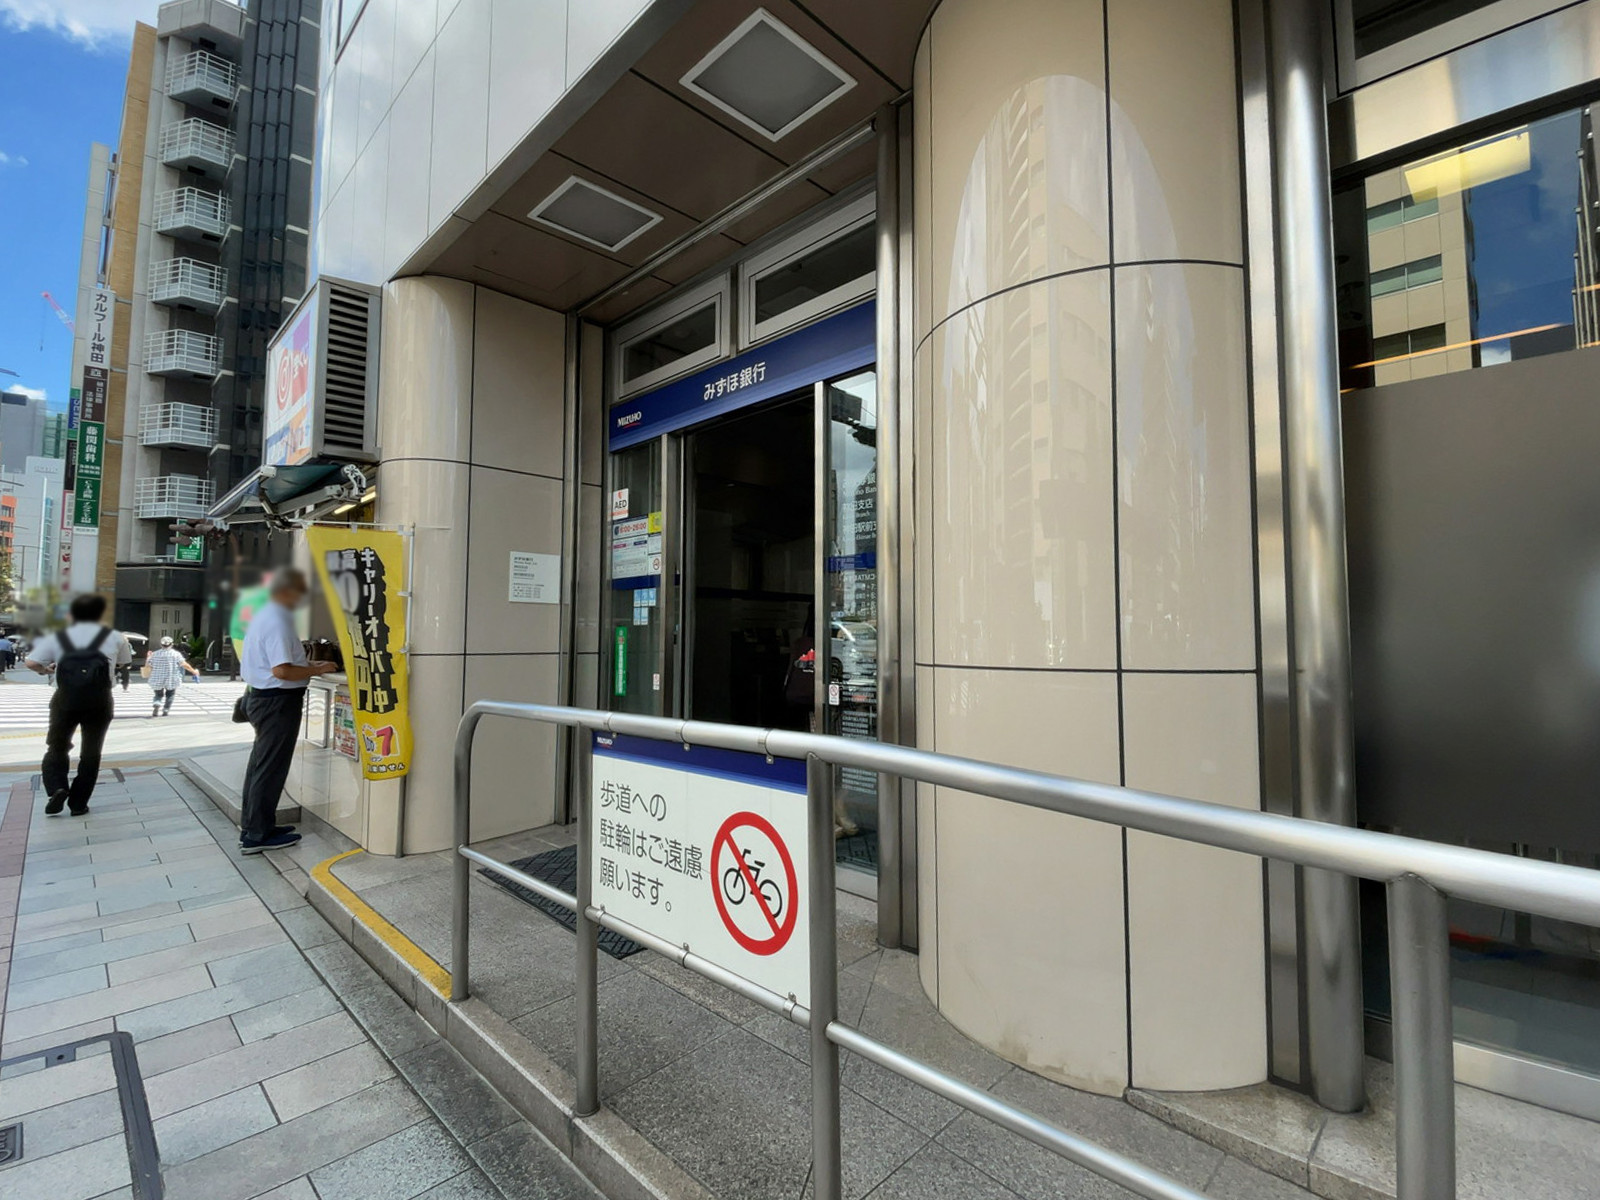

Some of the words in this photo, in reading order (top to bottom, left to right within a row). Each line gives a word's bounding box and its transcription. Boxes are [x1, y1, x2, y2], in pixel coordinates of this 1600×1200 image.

[90, 293, 107, 364] カルフール神田
[703, 361, 767, 401] みずほ銀行
[617, 411, 642, 427] MIZUHO
[614, 500, 627, 509] AED
[361, 548, 390, 713] キャリーオーバー中
[600, 780, 667, 822] 歩道への
[599, 818, 703, 881] 駐輪はご遠慮
[599, 857, 672, 912] 願います。
